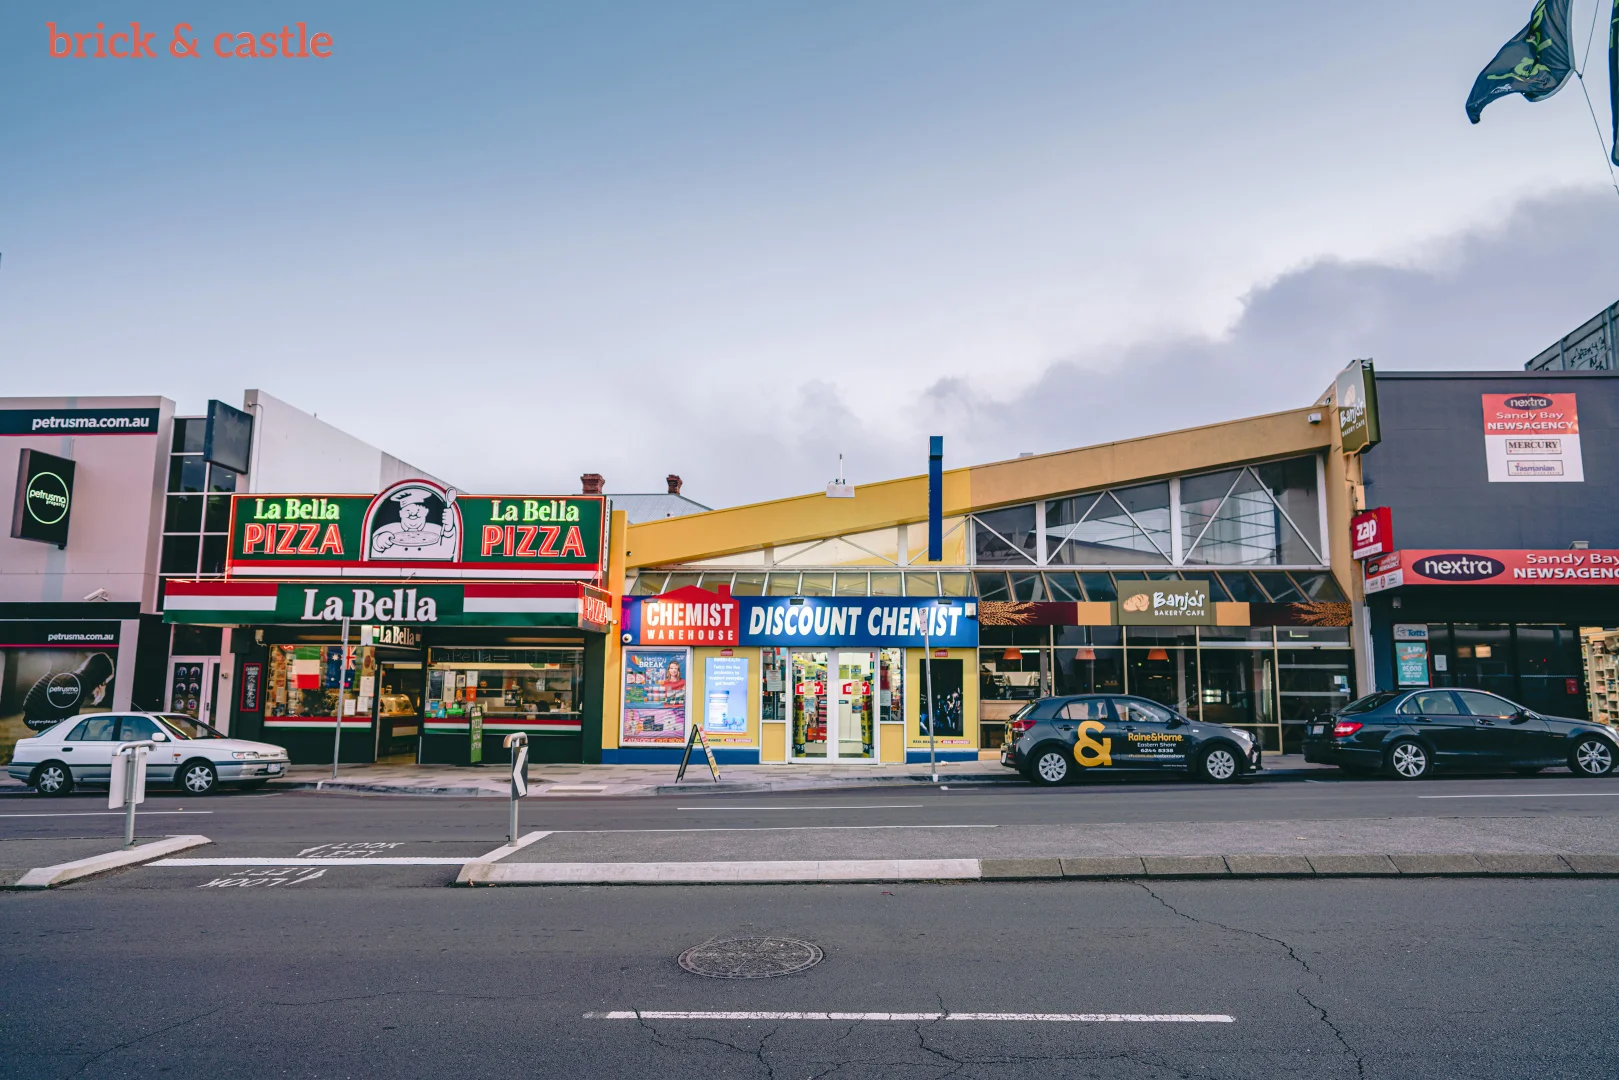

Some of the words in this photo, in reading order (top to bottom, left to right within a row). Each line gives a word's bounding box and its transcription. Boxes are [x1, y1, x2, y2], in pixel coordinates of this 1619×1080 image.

[1510, 397, 1547, 407] nextra
[31, 416, 150, 430] petrusma.com.au
[1496, 412, 1537, 420] Sandy
[1540, 412, 1563, 420] Bay
[1487, 421, 1574, 430] NEWSAGENCY
[1508, 441, 1558, 449] MERCURY
[1514, 464, 1555, 472] Tasmanian
[29, 489, 67, 504] petrusma
[253, 498, 281, 520] La
[284, 498, 341, 520] Bella
[490, 499, 518, 522] La
[522, 499, 580, 522] Bella
[242, 523, 345, 555] PIZZA
[1356, 519, 1377, 542] zap
[480, 524, 587, 558] PIZZA
[1425, 557, 1493, 575] nextra
[1526, 553, 1585, 566] Sandy
[301, 589, 344, 621] La
[350, 588, 438, 622] Bella
[1153, 590, 1205, 611] Banjo's
[583, 596, 608, 624] PIZZA
[646, 603, 734, 627] CHEMIST
[749, 606, 862, 636] DISCOUNT
[867, 606, 963, 636] CHEMIST
[48, 633, 114, 641] petrusma.com.au
[379, 625, 391, 643] La
[392, 625, 414, 646] Bella
[647, 629, 734, 641] WAREHOUSE
[306, 850, 384, 858] LEFT
